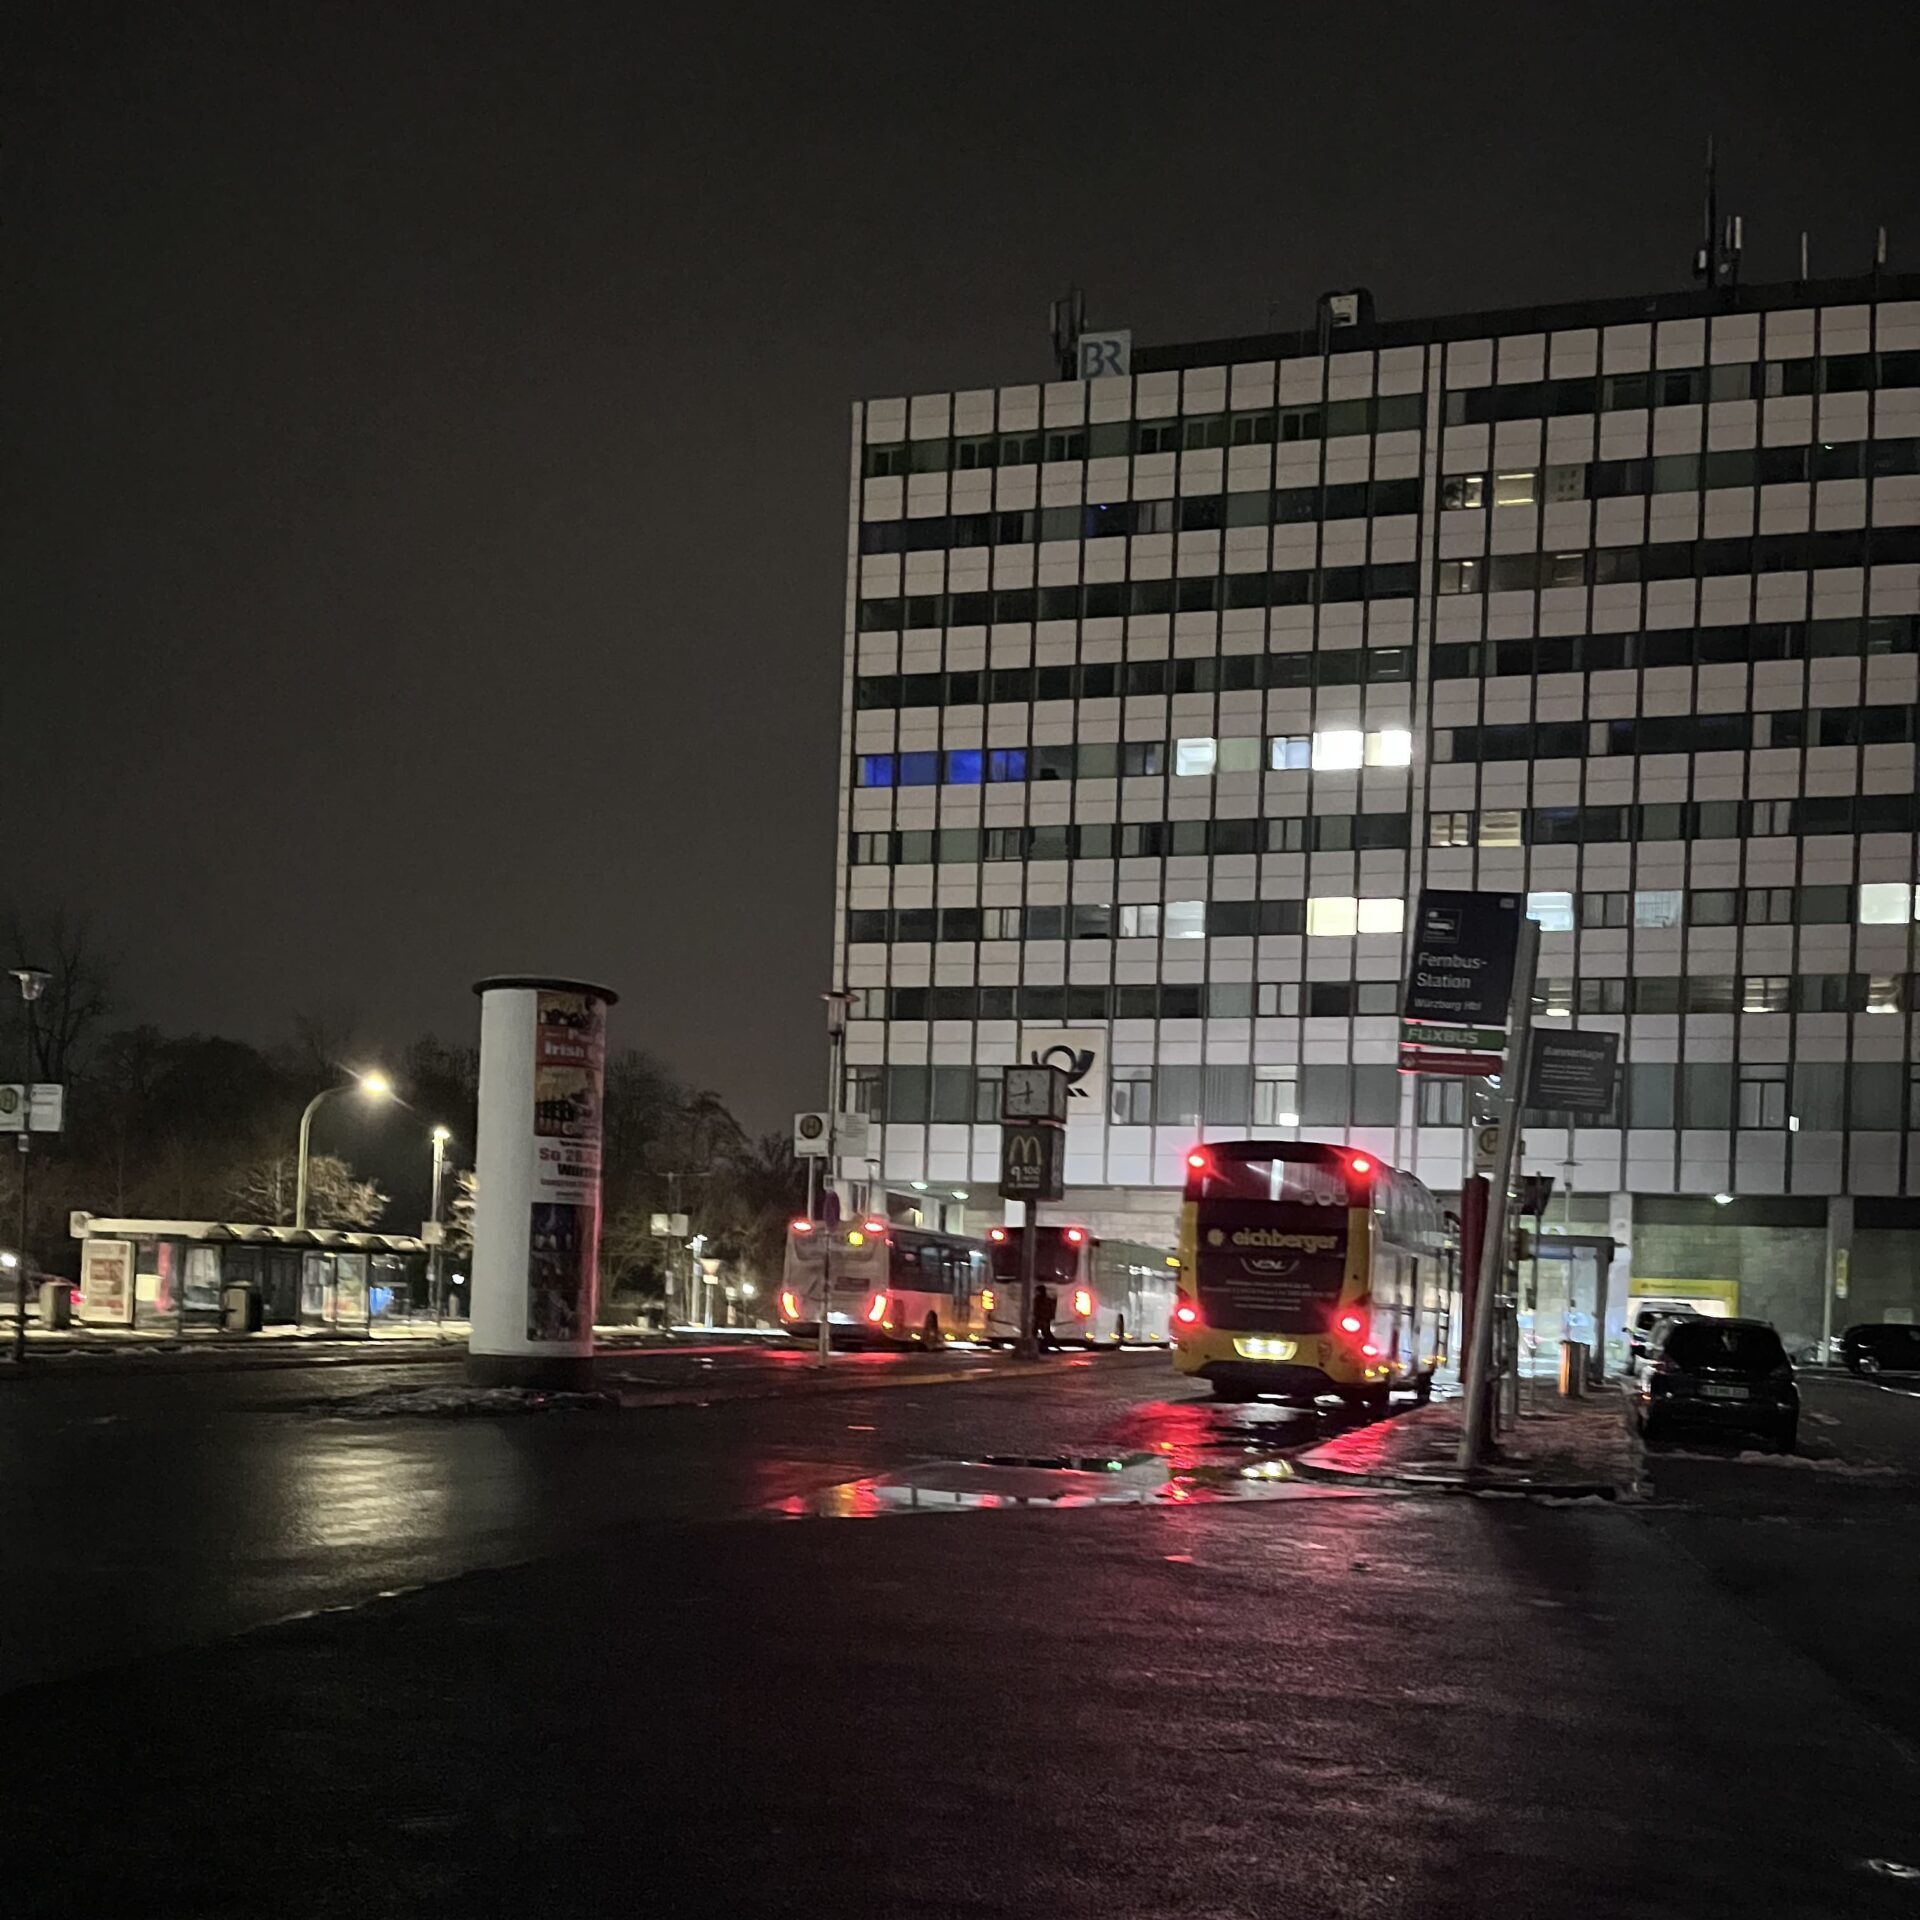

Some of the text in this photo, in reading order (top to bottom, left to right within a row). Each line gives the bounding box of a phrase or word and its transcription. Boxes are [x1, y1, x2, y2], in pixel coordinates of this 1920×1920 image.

[1081, 341, 1125, 379] BR
[1418, 952, 1487, 969] Fernbus-
[1417, 972, 1471, 989] Station
[1232, 1228, 1339, 1254] eichberger
